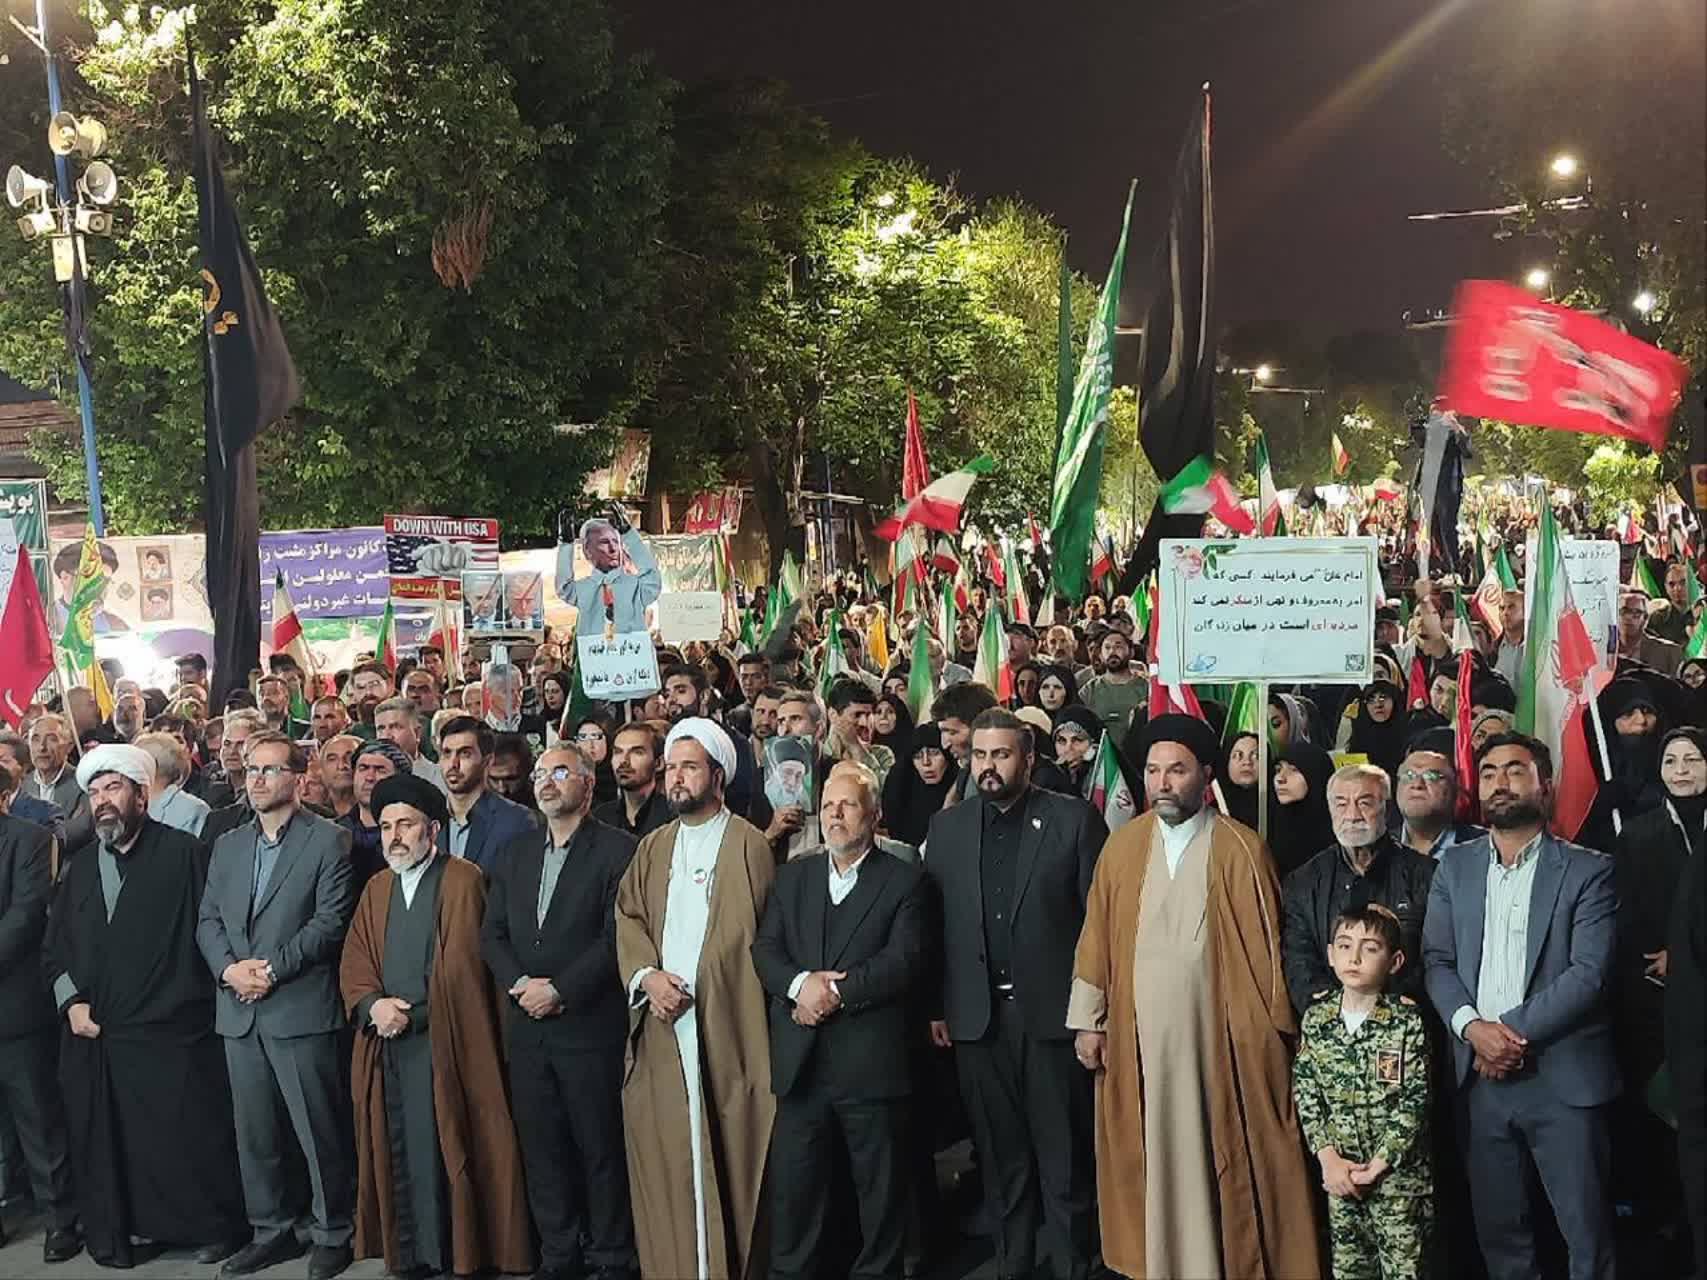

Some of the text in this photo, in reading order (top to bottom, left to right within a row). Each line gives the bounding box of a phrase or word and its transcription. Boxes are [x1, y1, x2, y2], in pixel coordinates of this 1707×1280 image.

[393, 518, 488, 537] DOWN WITH USA
[308, 541, 341, 561] مراکز
[346, 541, 381, 560] کانون
[1213, 570, 1225, 580] که
[1229, 570, 1253, 582] کسی
[1261, 569, 1296, 582] فرمایند
[1344, 570, 1363, 582] امام
[1192, 594, 1208, 605] کند
[1210, 596, 1229, 607] نمی
[1266, 595, 1286, 607] نهی
[1346, 596, 1363, 607] امر
[1232, 618, 1257, 632] میان
[1262, 620, 1275, 632] در
[1279, 618, 1310, 631] است
